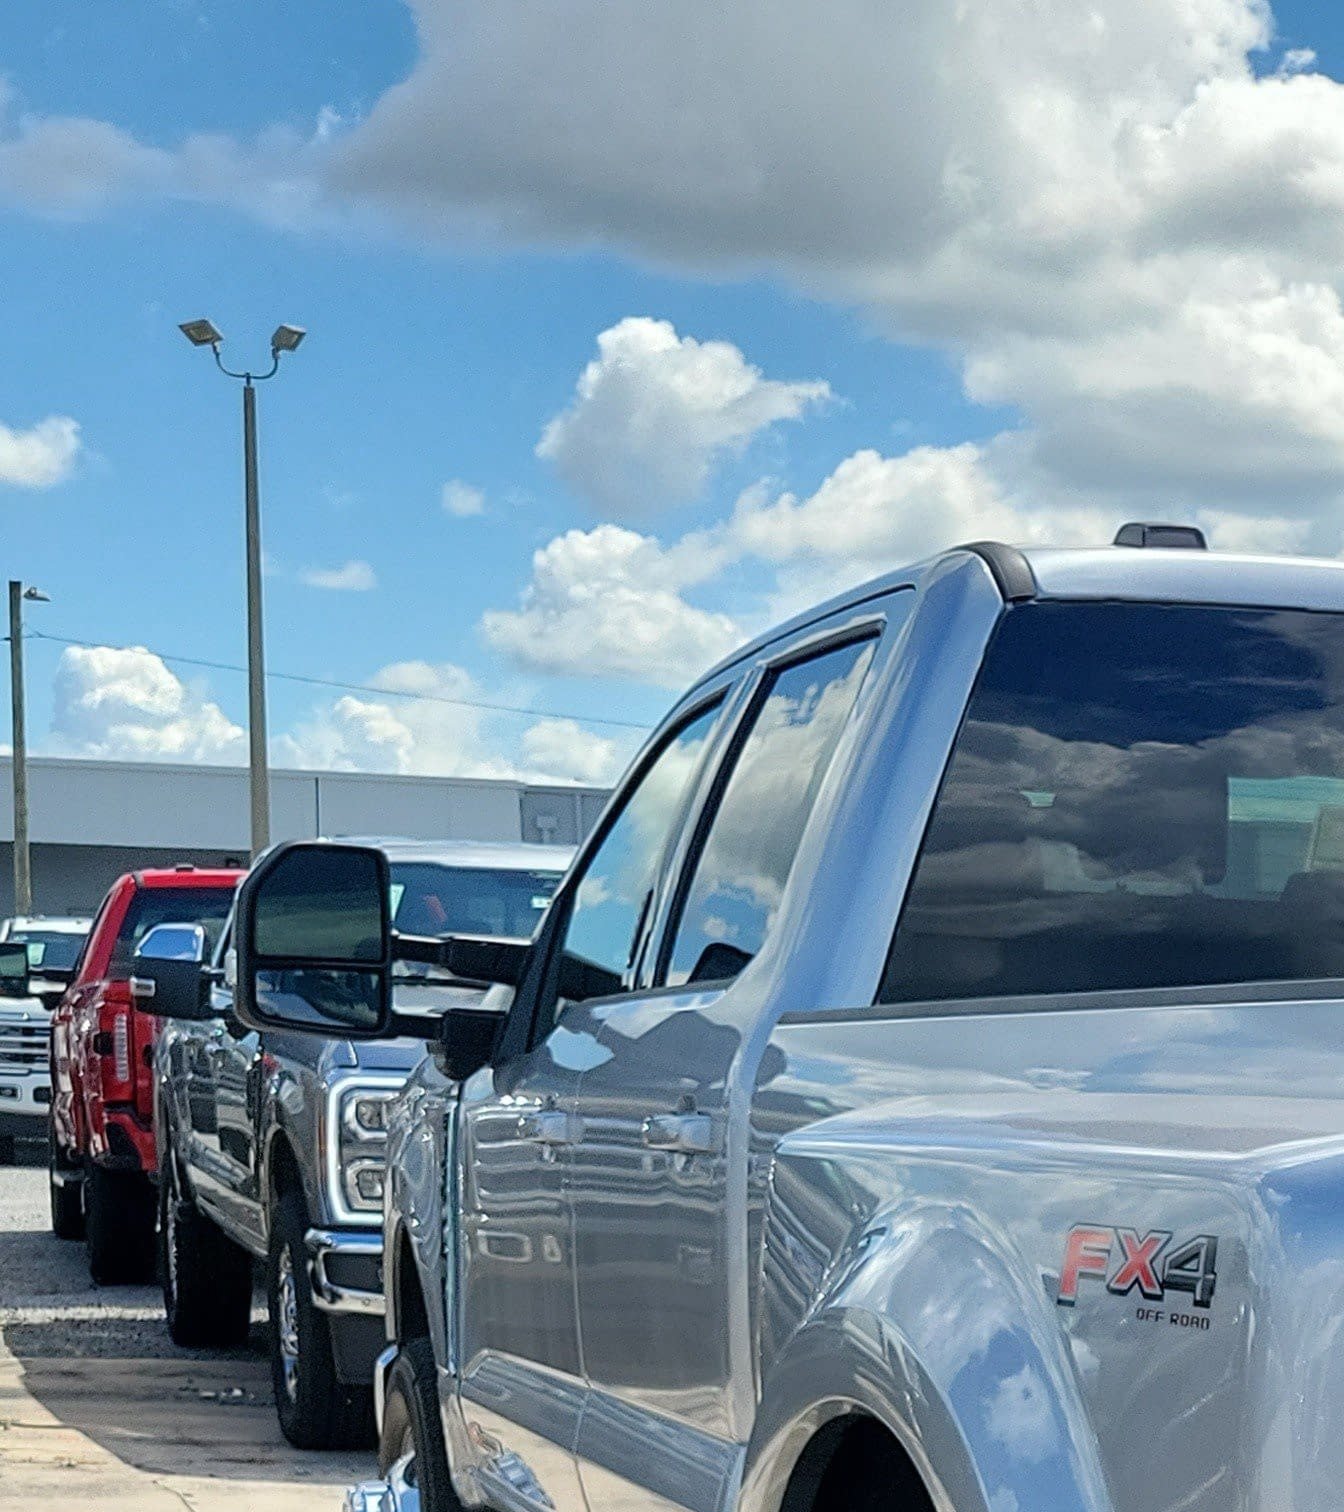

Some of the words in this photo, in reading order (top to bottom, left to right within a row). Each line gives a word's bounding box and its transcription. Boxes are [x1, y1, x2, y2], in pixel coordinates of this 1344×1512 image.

[1056, 1222, 1219, 1309] FX4
[1136, 1307, 1165, 1322] OFF
[1169, 1312, 1211, 1331] ROAD
